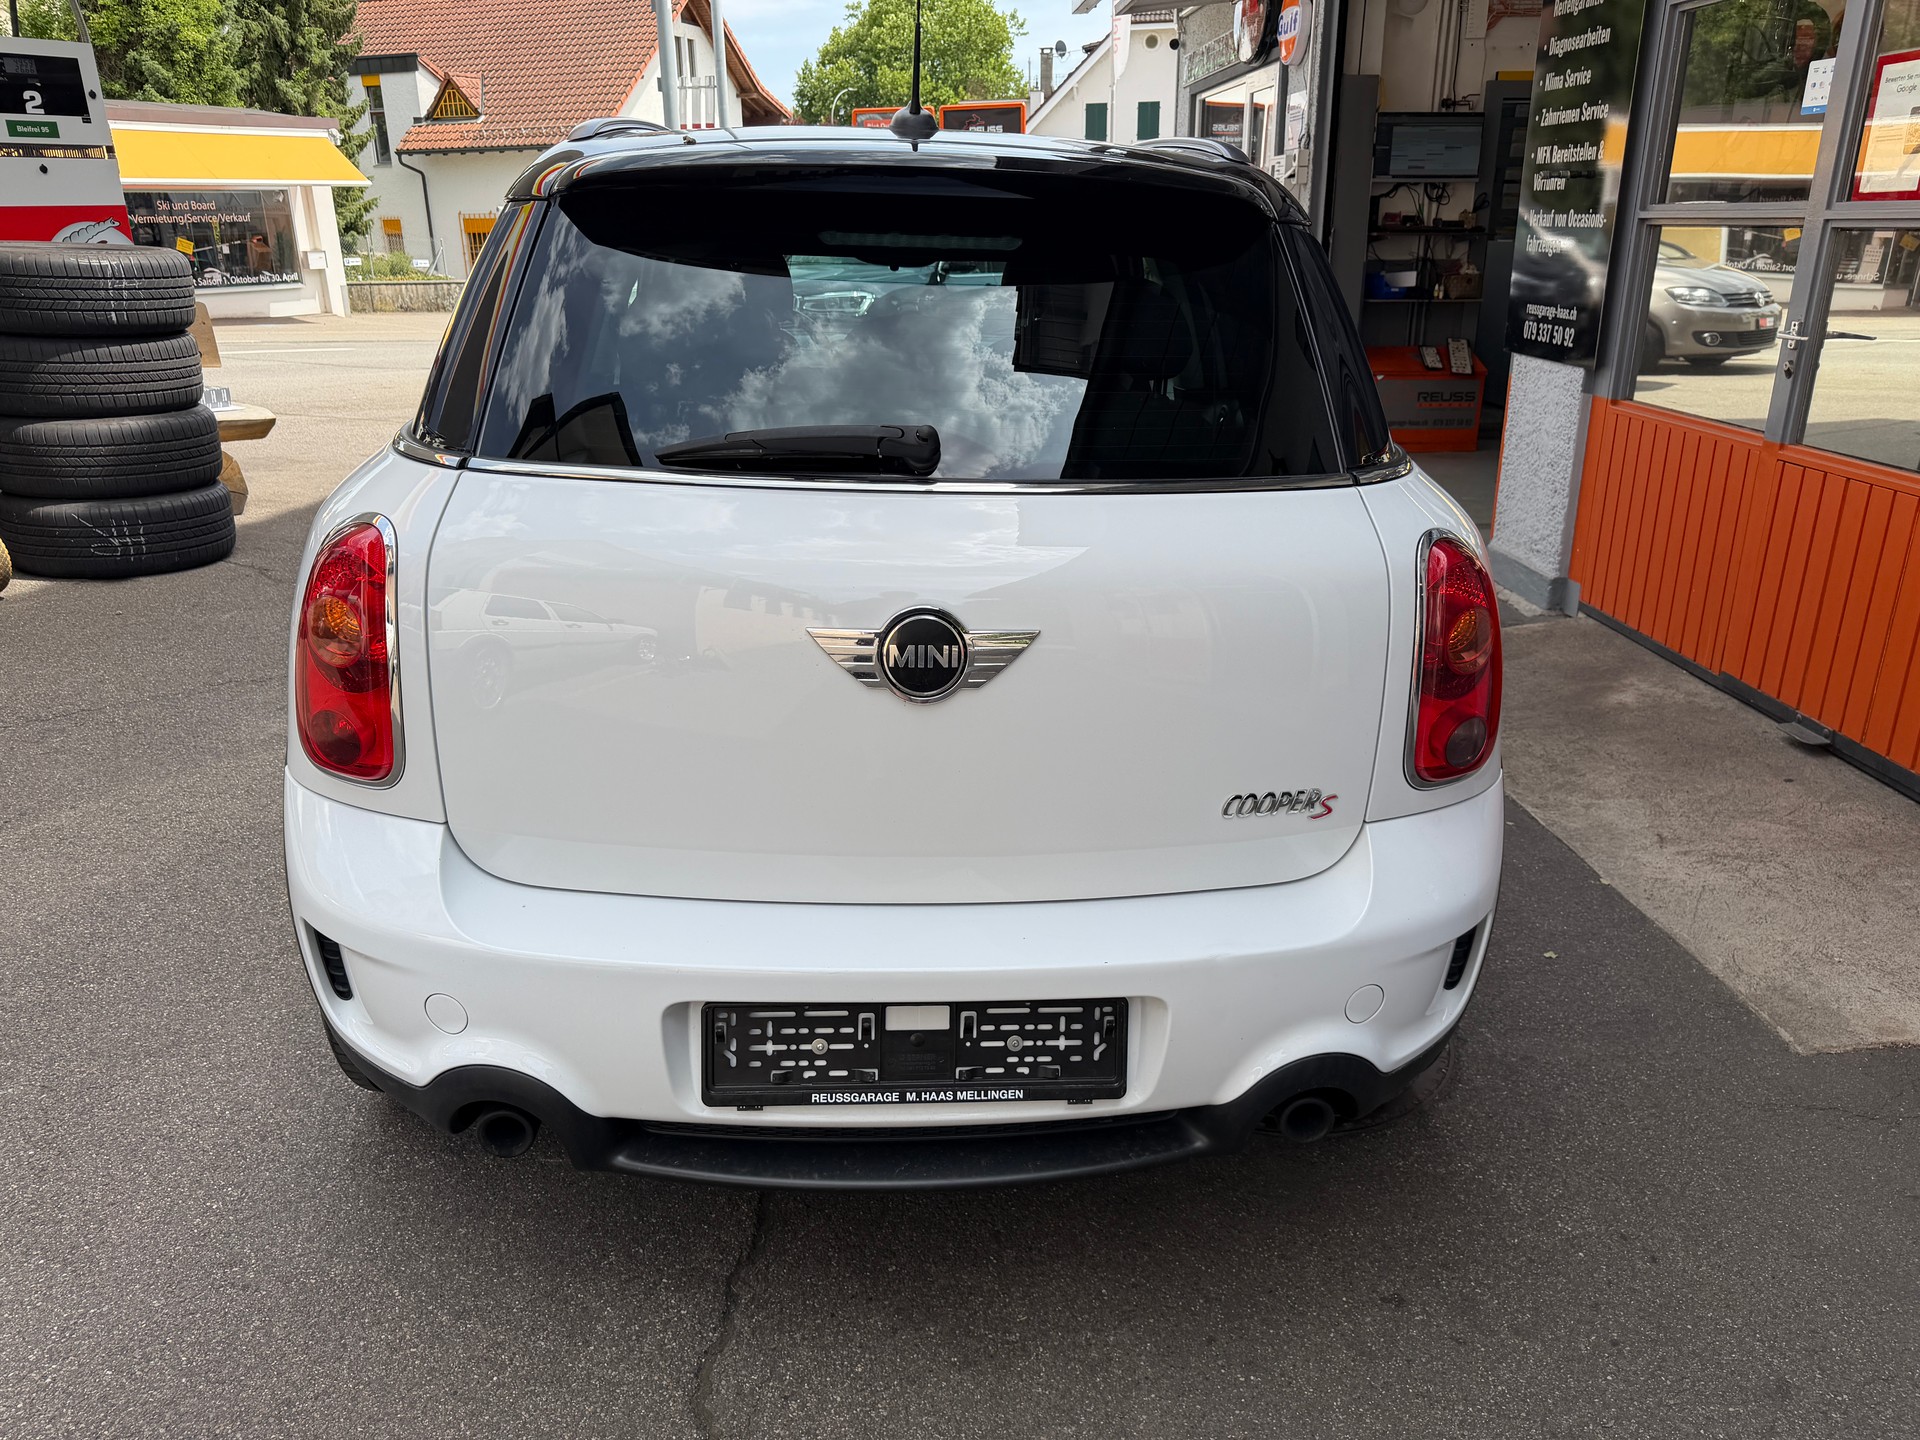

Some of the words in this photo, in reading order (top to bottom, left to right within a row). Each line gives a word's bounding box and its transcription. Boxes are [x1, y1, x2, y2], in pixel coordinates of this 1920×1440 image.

[1553, 0, 1604, 17] Reifengaran
[1278, 10, 1298, 36] Gulf
[1549, 25, 1611, 58] Diagnosearbeiten
[1544, 71, 1564, 91] Klima
[1564, 66, 1592, 88] Service
[1896, 83, 1918, 94] Google
[22, 90, 45, 114] 2
[1540, 106, 1580, 127] Zahnriemen
[1581, 100, 1609, 122] Service
[1536, 146, 1551, 164] MFK
[1552, 142, 1596, 163] Bereitstellen
[1598, 140, 1605, 160] &
[156, 200, 170, 210] Ski
[173, 200, 189, 210] und
[192, 200, 216, 210] Board
[1530, 209, 1555, 228] Verkauf
[1555, 213, 1567, 228] von
[1568, 208, 1607, 228] Occasions-
[198, 276, 222, 286] Saison
[231, 274, 259, 284] Oktober
[260, 273, 271, 283] bis
[272, 273, 281, 282] 30.
[282, 272, 298, 283] April
[1526, 303, 1578, 320] reussgarage-haas.ch
[1523, 320, 1537, 340] 079
[1538, 322, 1552, 344] 337
[1552, 325, 1563, 346] 50
[1564, 328, 1575, 348] 92
[1417, 391, 1476, 402] REUSS
[888, 644, 959, 668] MINI
[811, 1092, 900, 1102] REUSSGARAGE
[906, 1092, 920, 1102] M.
[922, 1092, 954, 1101] HAAS
[956, 1090, 1024, 1100] MELLINGEN
